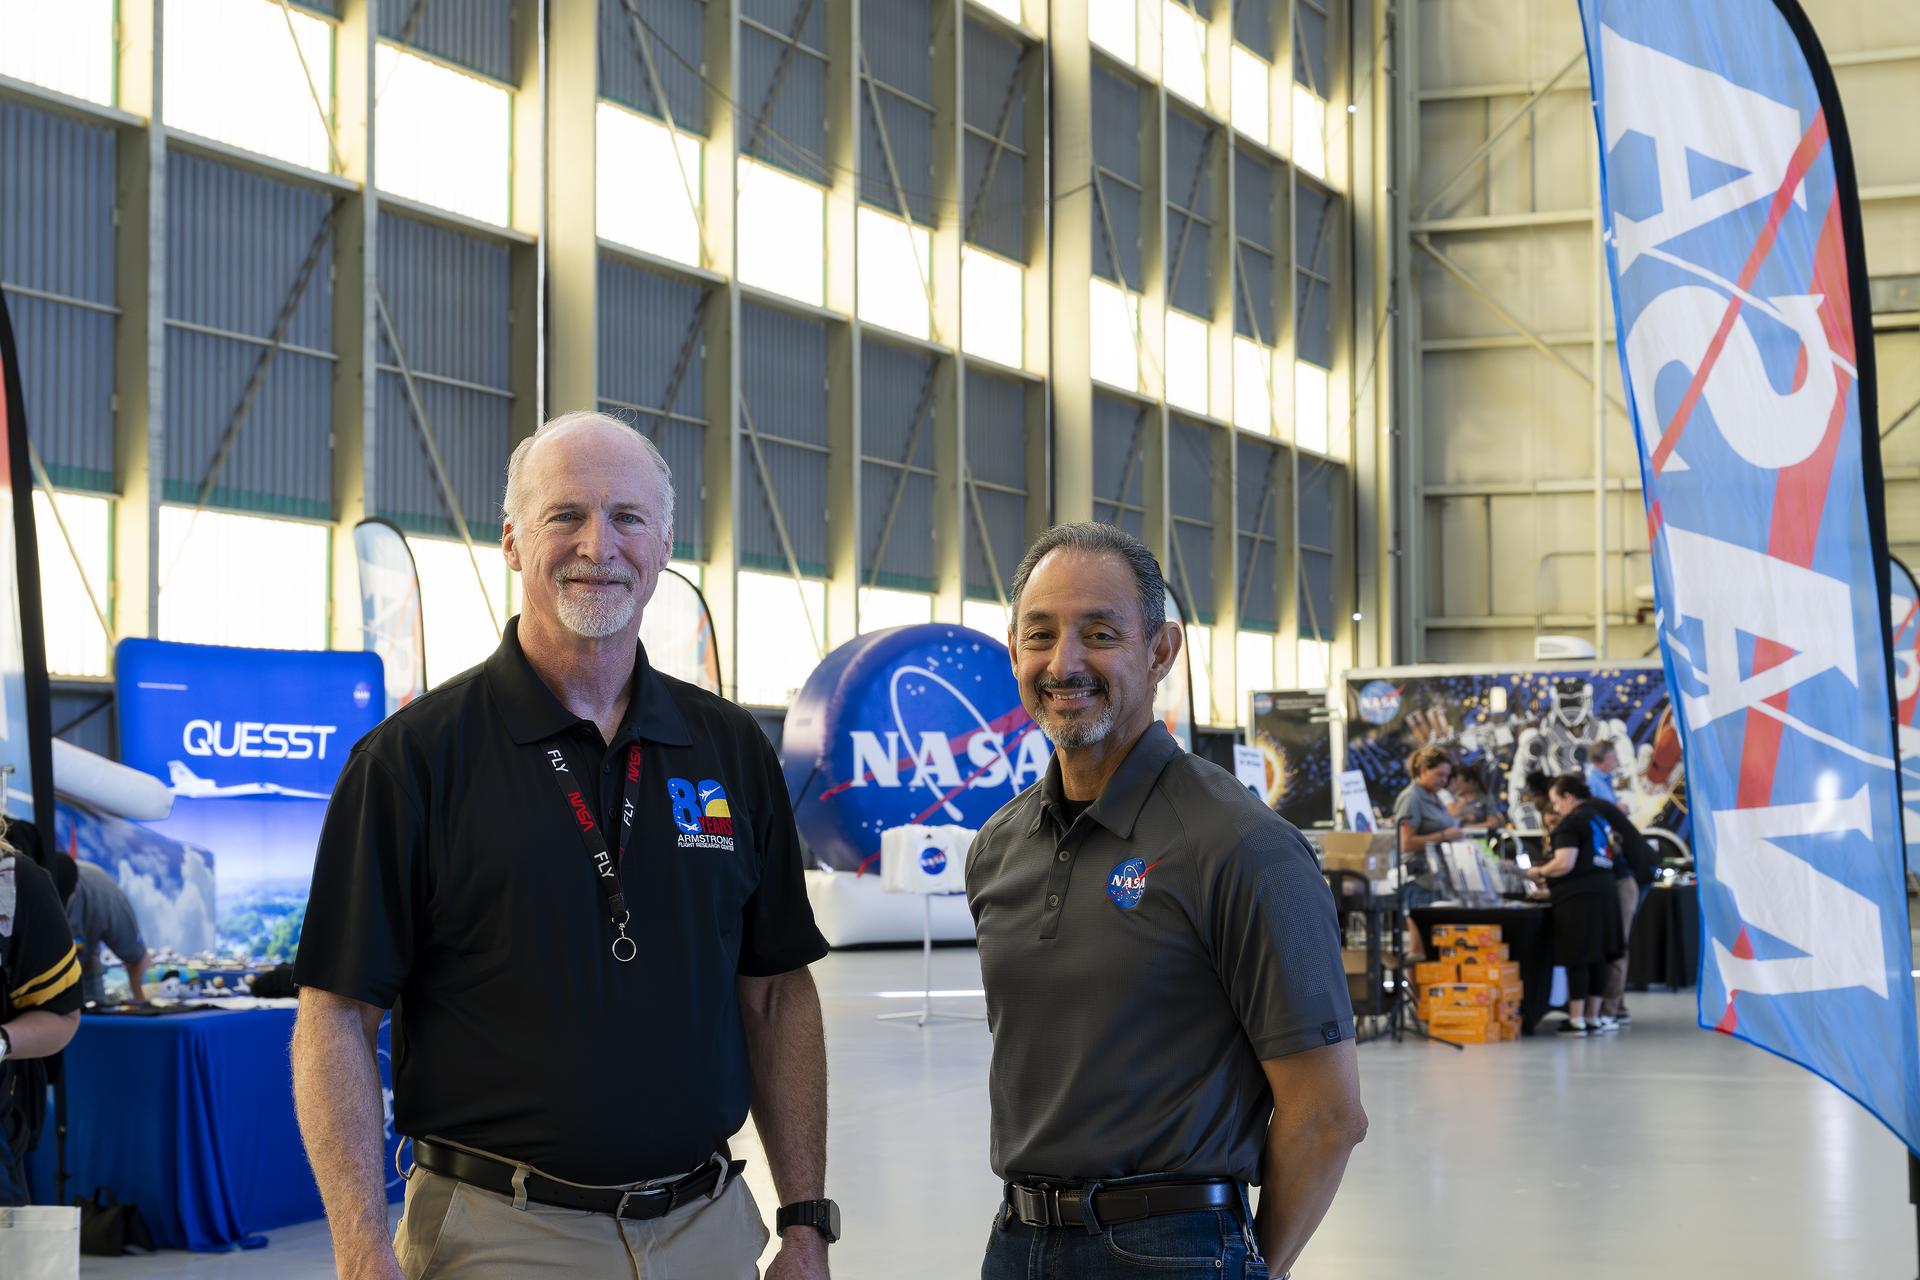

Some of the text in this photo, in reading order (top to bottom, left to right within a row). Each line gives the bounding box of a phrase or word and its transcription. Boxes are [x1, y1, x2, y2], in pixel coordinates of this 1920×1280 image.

[183, 719, 337, 760] QUESST
[849, 730, 1051, 789] NASA
[547, 749, 615, 878] FLY NASA FLY
[623, 798, 635, 827] FLY
[697, 816, 733, 836] YEARS
[677, 834, 734, 846] ARMSTRONG
[1111, 874, 1146, 889] NASA
